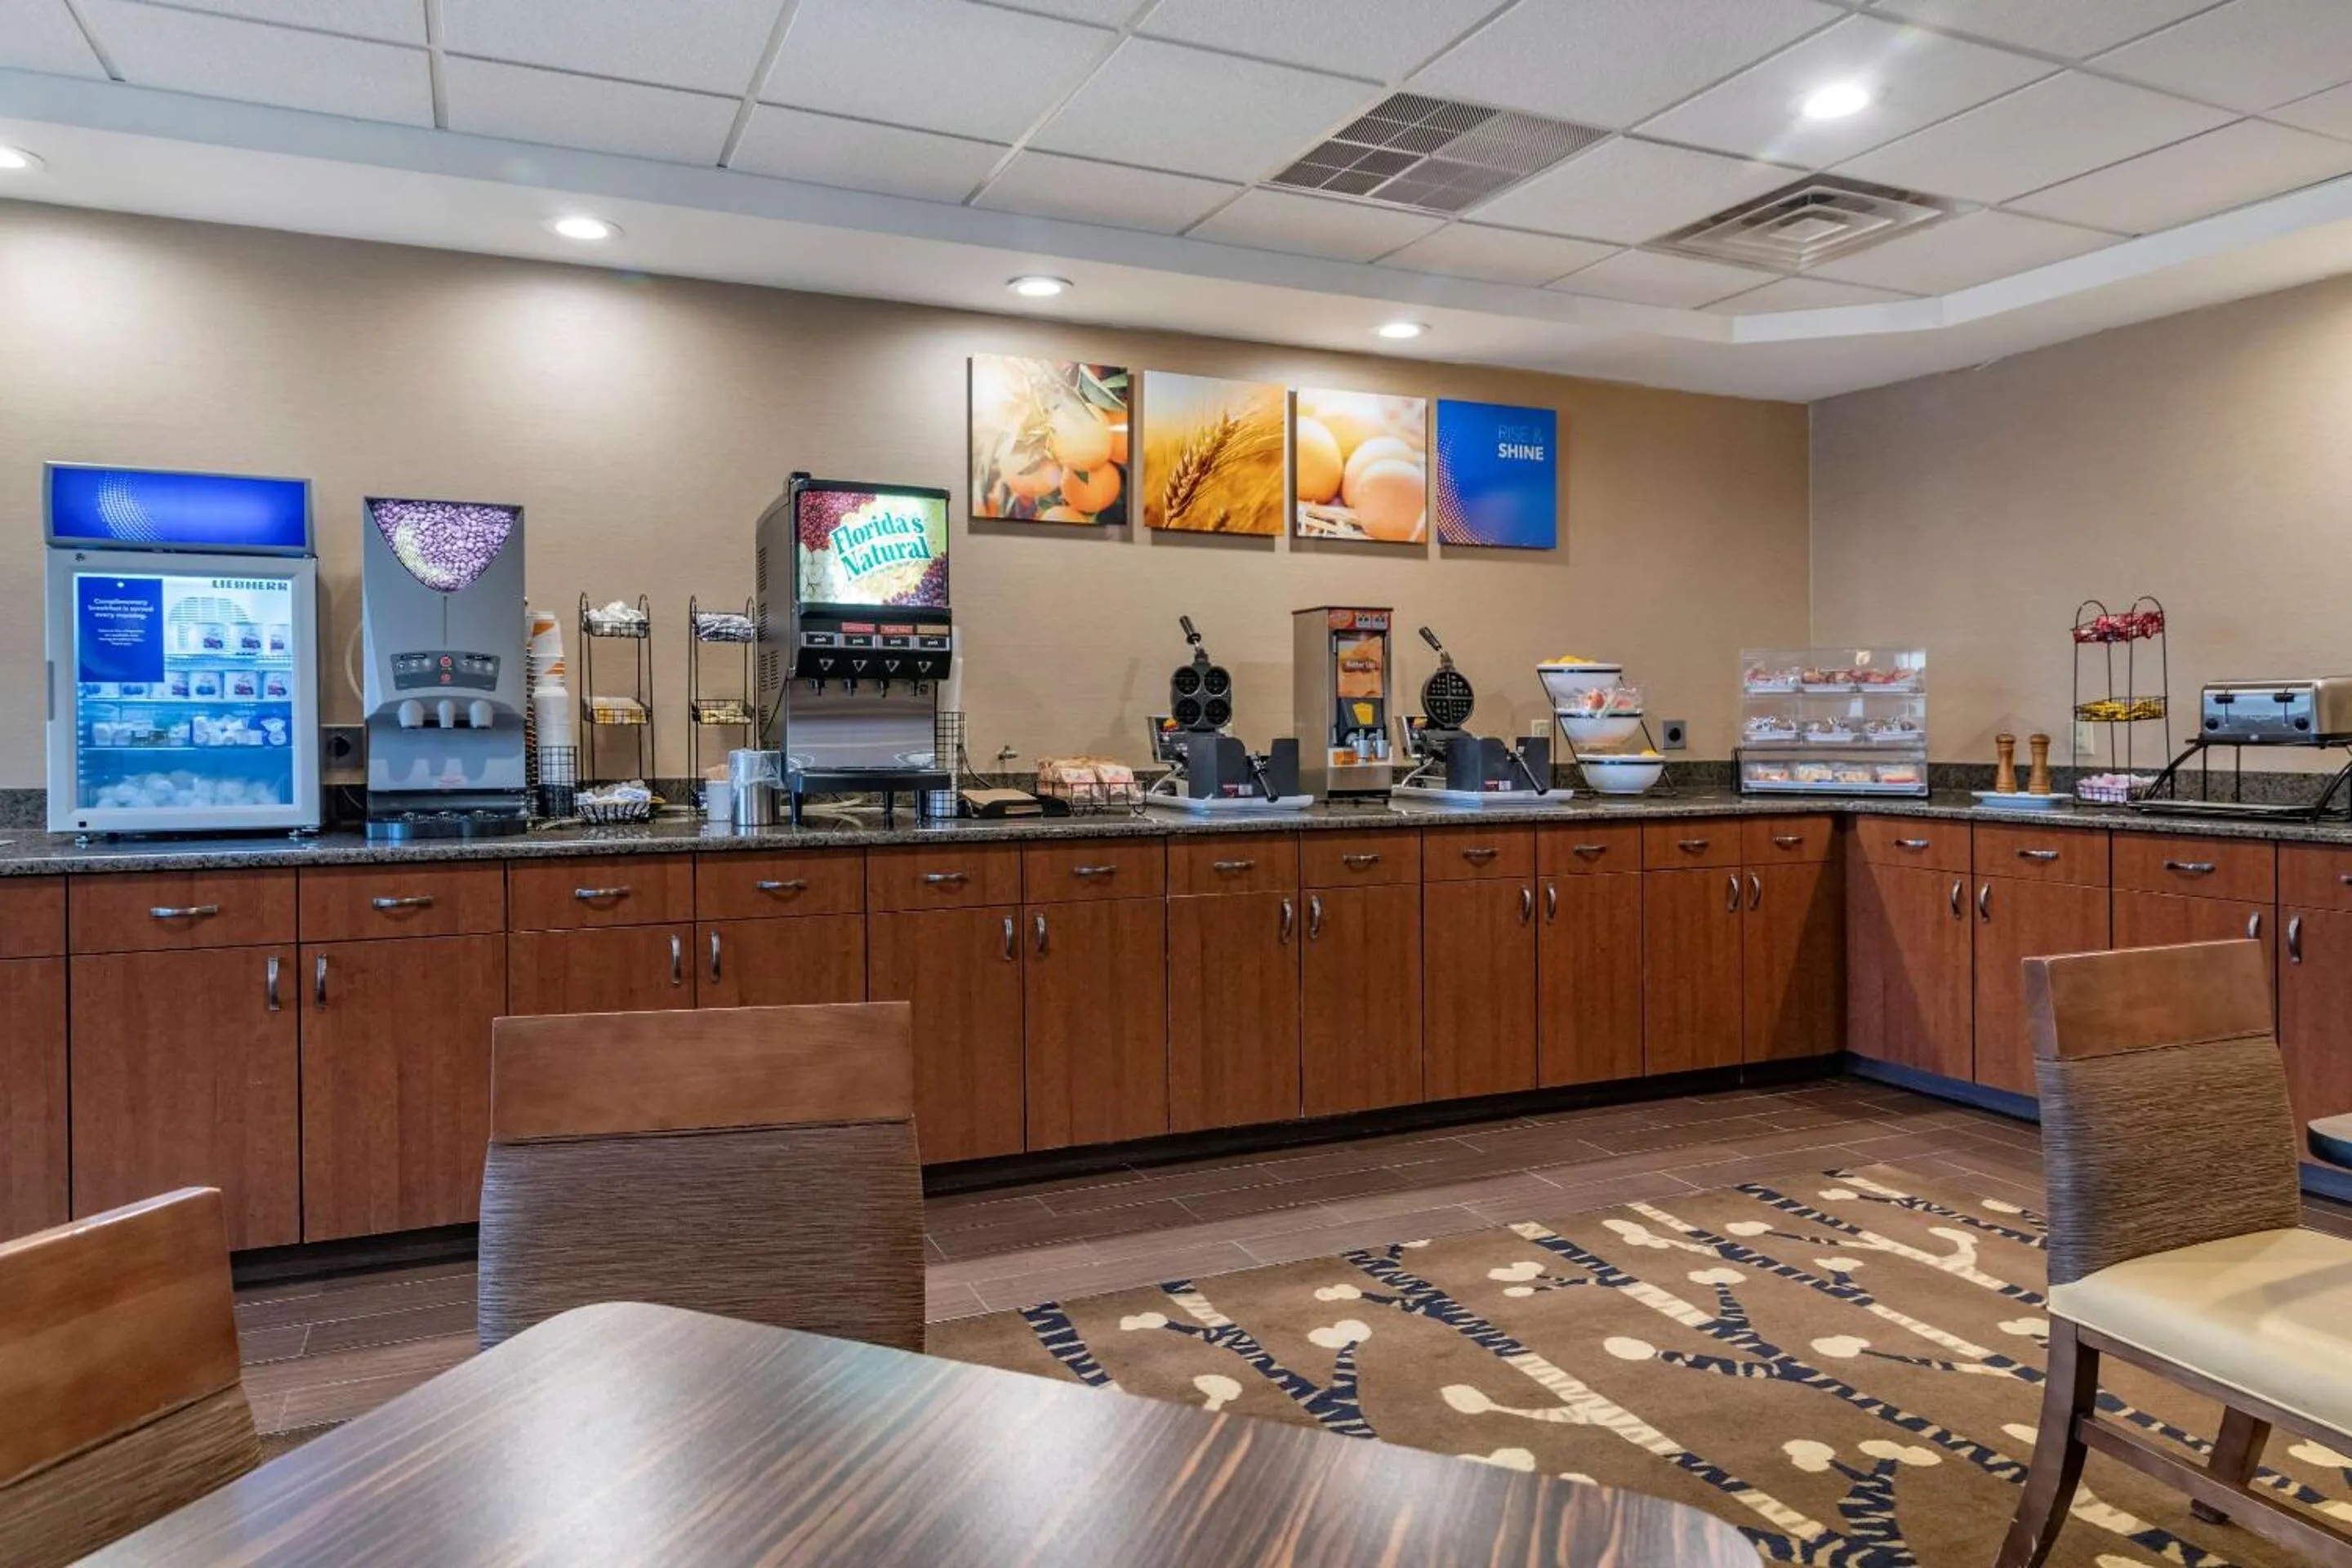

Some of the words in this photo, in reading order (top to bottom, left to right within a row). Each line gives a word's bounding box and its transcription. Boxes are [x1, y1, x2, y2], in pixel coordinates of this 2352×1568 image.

[1498, 425, 1530, 443] RISE
[1533, 426, 1543, 443] &
[1498, 443, 1544, 461] SHINE
[840, 536, 932, 581] Natural
[212, 579, 287, 590] LIEBHERR
